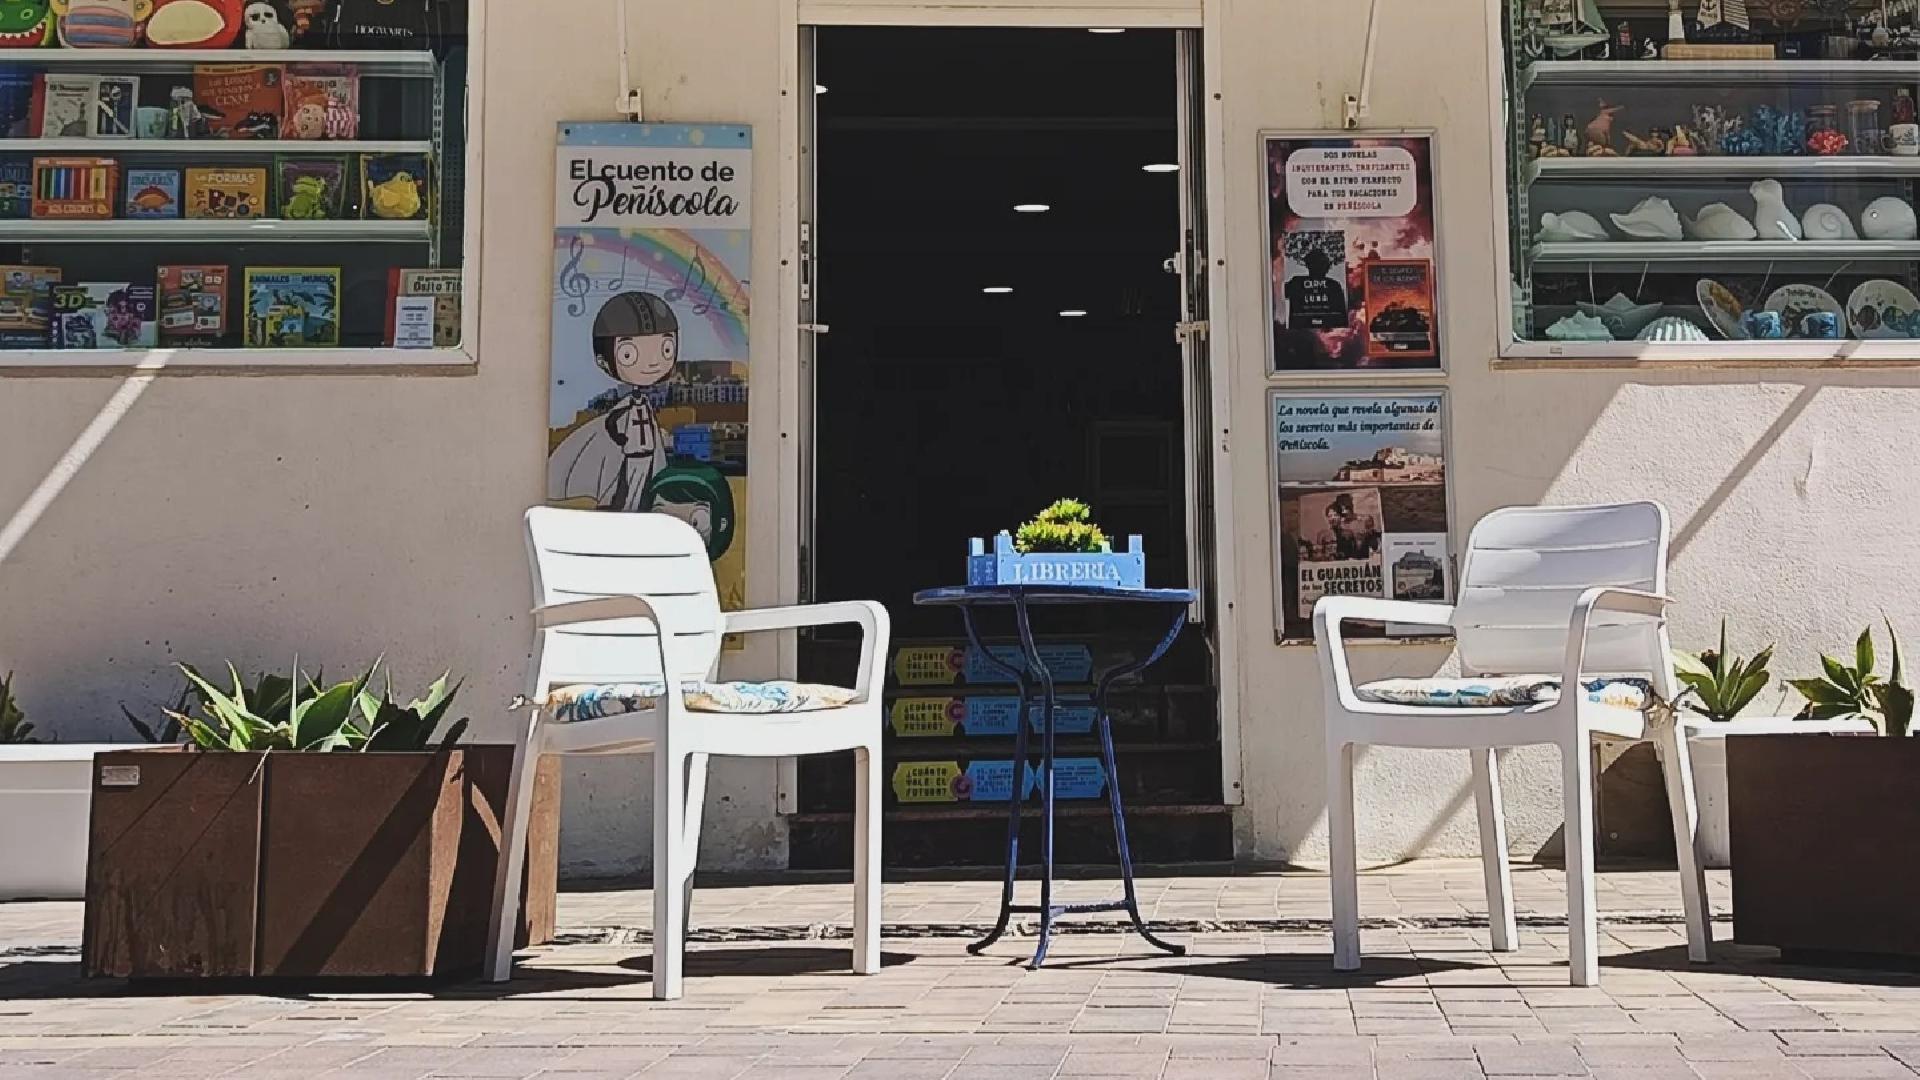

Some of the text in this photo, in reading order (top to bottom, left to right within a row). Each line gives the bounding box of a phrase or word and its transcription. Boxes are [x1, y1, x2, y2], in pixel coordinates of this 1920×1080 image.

[1323, 151, 1378, 159] DOS NOVELAS
[207, 173, 257, 184] FORMAS
[601, 161, 694, 182] cuento
[701, 161, 735, 181] de
[1301, 176, 1402, 186] CON EL RITMO PERFECTO
[573, 176, 740, 223] Peñíscola
[1307, 188, 1398, 198] PARA TUS VACACIONES
[54, 293, 84, 309] 3D
[1277, 401, 1438, 418] La novela que revela algunos de
[1279, 418, 1435, 434] los secretos más importantes de
[1013, 561, 1122, 582] LIBRERIA
[1301, 561, 1382, 582] EL GUARDIÁN
[1323, 580, 1384, 595] SECRETOS
